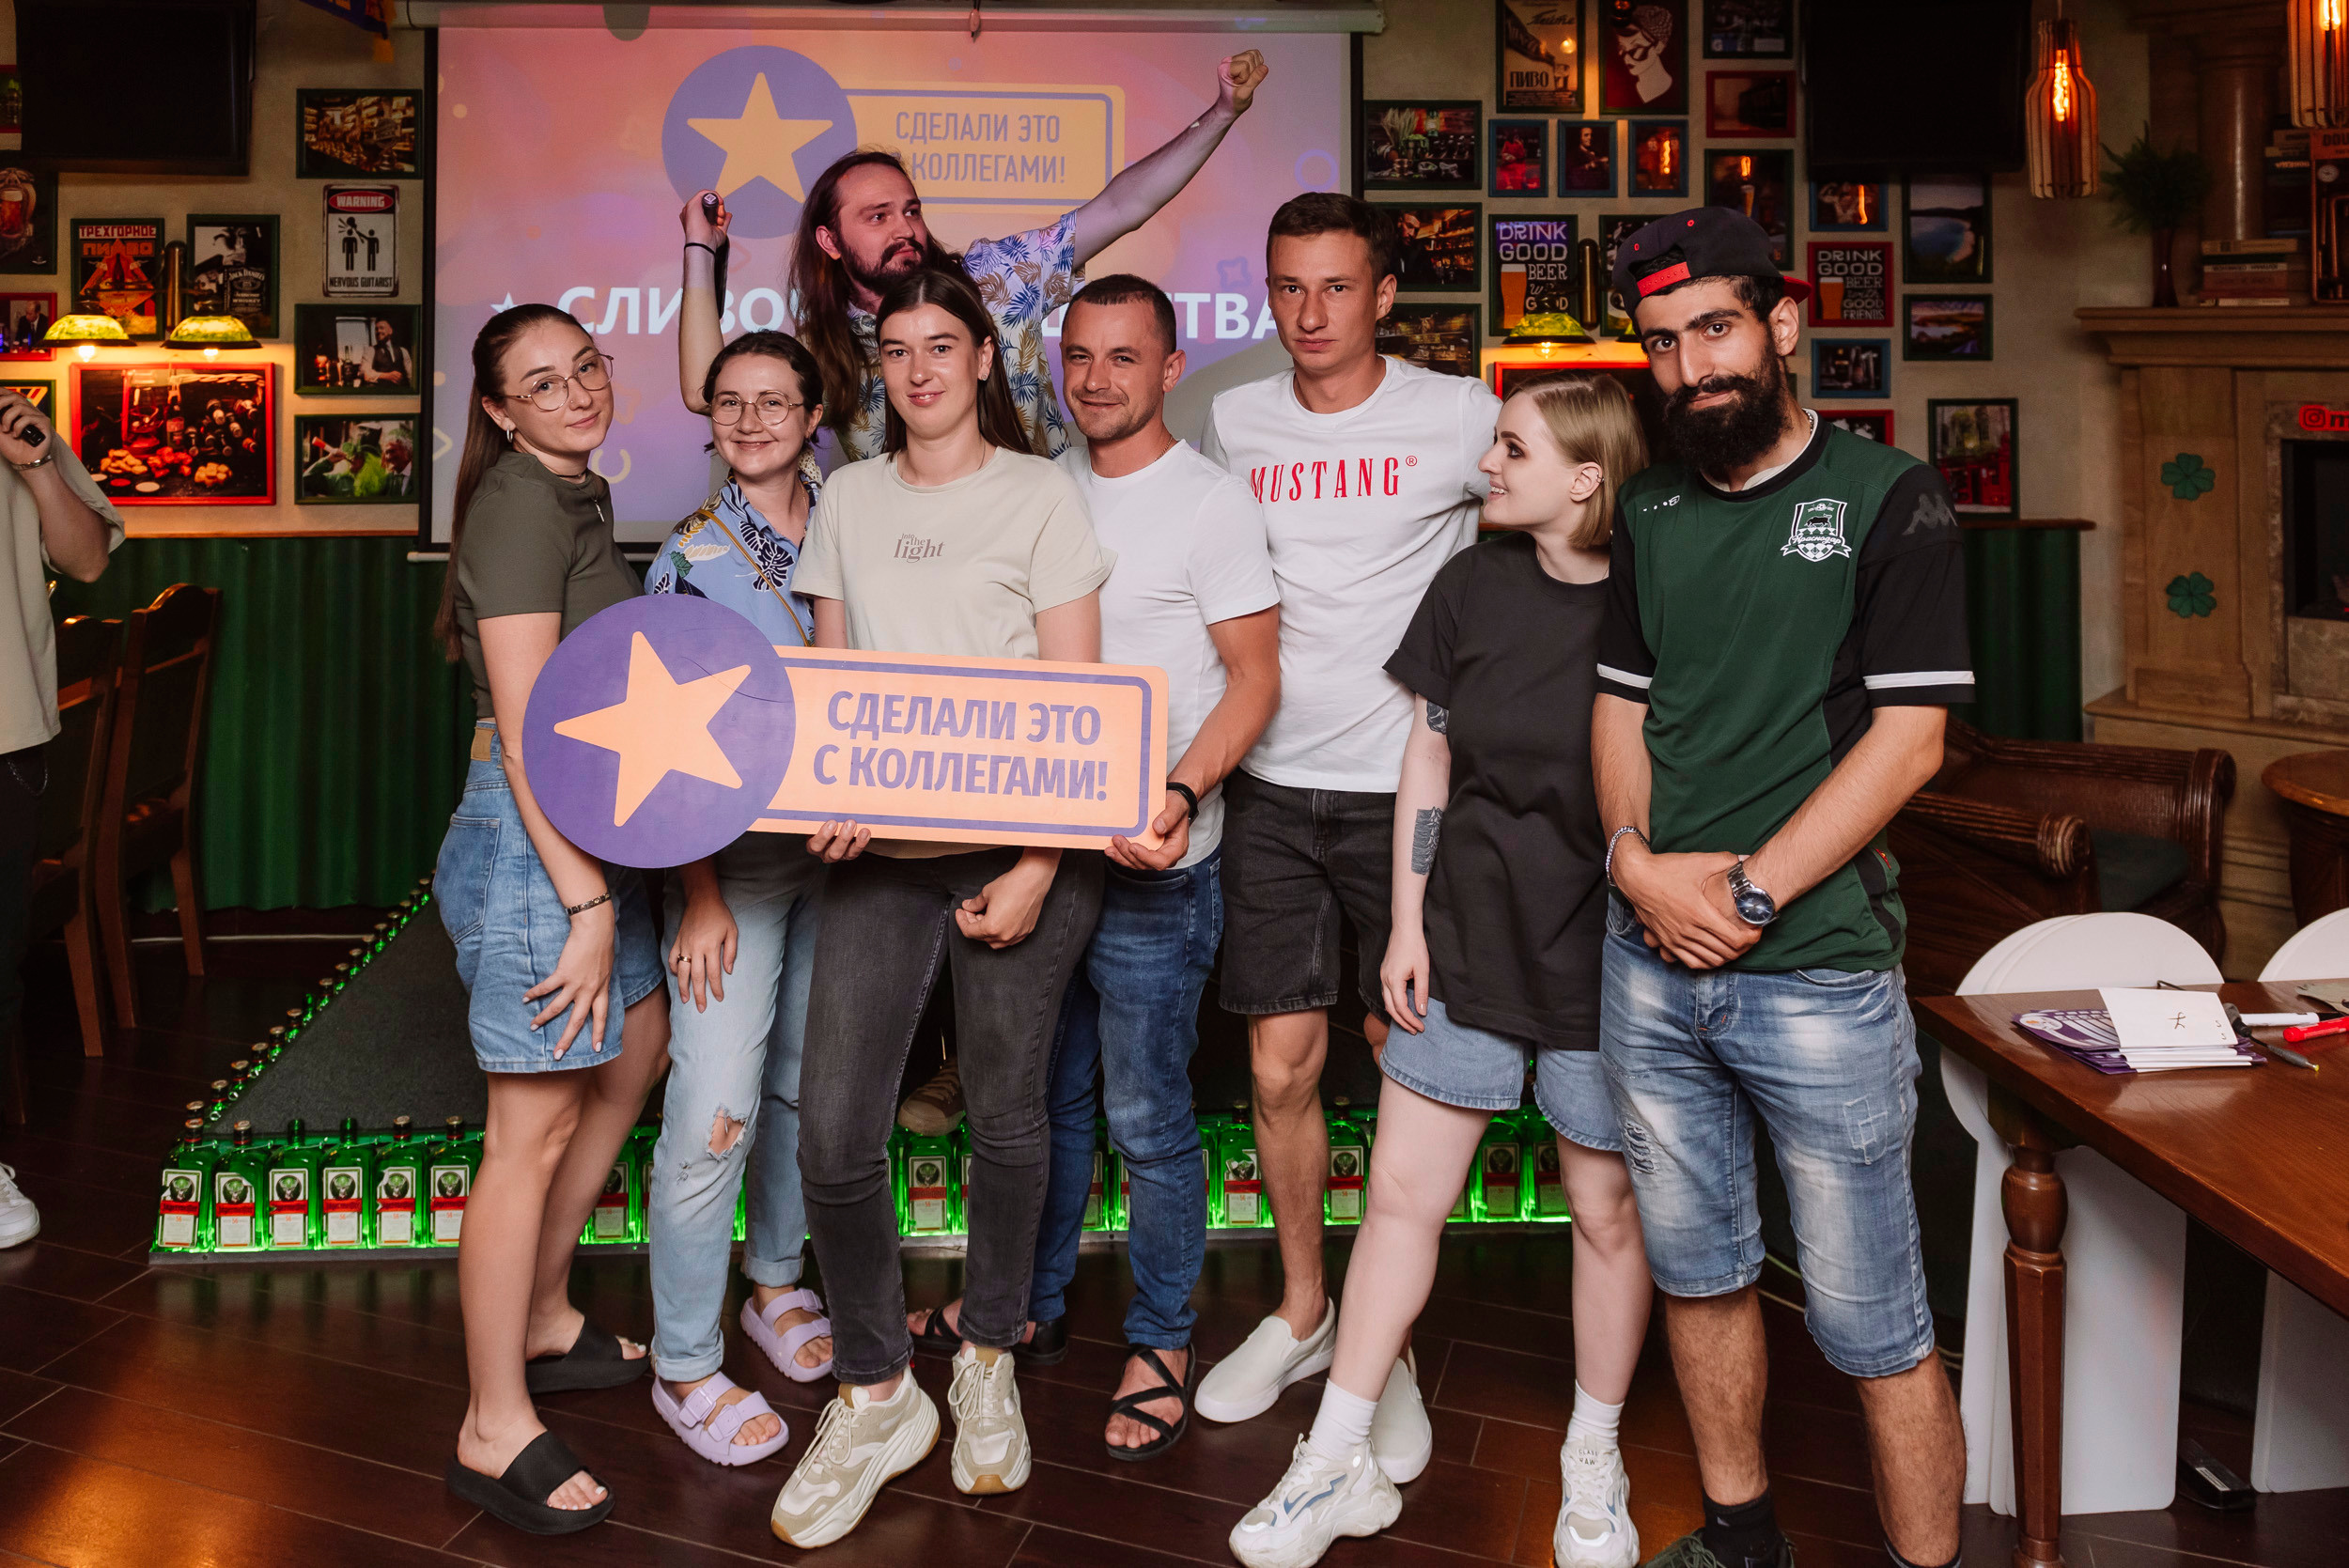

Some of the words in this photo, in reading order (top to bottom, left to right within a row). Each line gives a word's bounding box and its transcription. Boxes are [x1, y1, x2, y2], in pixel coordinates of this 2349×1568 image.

[1510, 70, 1549, 88] ПИВО
[895, 111, 1008, 145] СДЕЛАЛИ
[1018, 114, 1061, 144] ЭТО
[911, 152, 1066, 184] КОЛЛЕГАМИ!
[336, 195, 385, 208] WARNING
[80, 225, 157, 238] ТРЕХГОРНОЕ
[1499, 224, 1568, 241] DRINK
[1499, 242, 1568, 261] GOOD
[1818, 250, 1882, 261] DRINK
[1528, 263, 1568, 281] BEER
[1817, 262, 1884, 275] GOOD
[329, 276, 359, 287] NERVOUS
[361, 276, 393, 287] GUITARIST
[1845, 276, 1883, 288] BEER
[1843, 299, 1885, 309] GOOD
[1843, 309, 1885, 319] FRIENDS
[910, 536, 926, 546] the
[894, 538, 945, 564] light
[827, 691, 1017, 740] СДЕЛАЛИ
[1026, 702, 1101, 746] ЭТО
[813, 744, 840, 785] С
[848, 747, 1108, 801] КОЛЛЕГАМИ!
